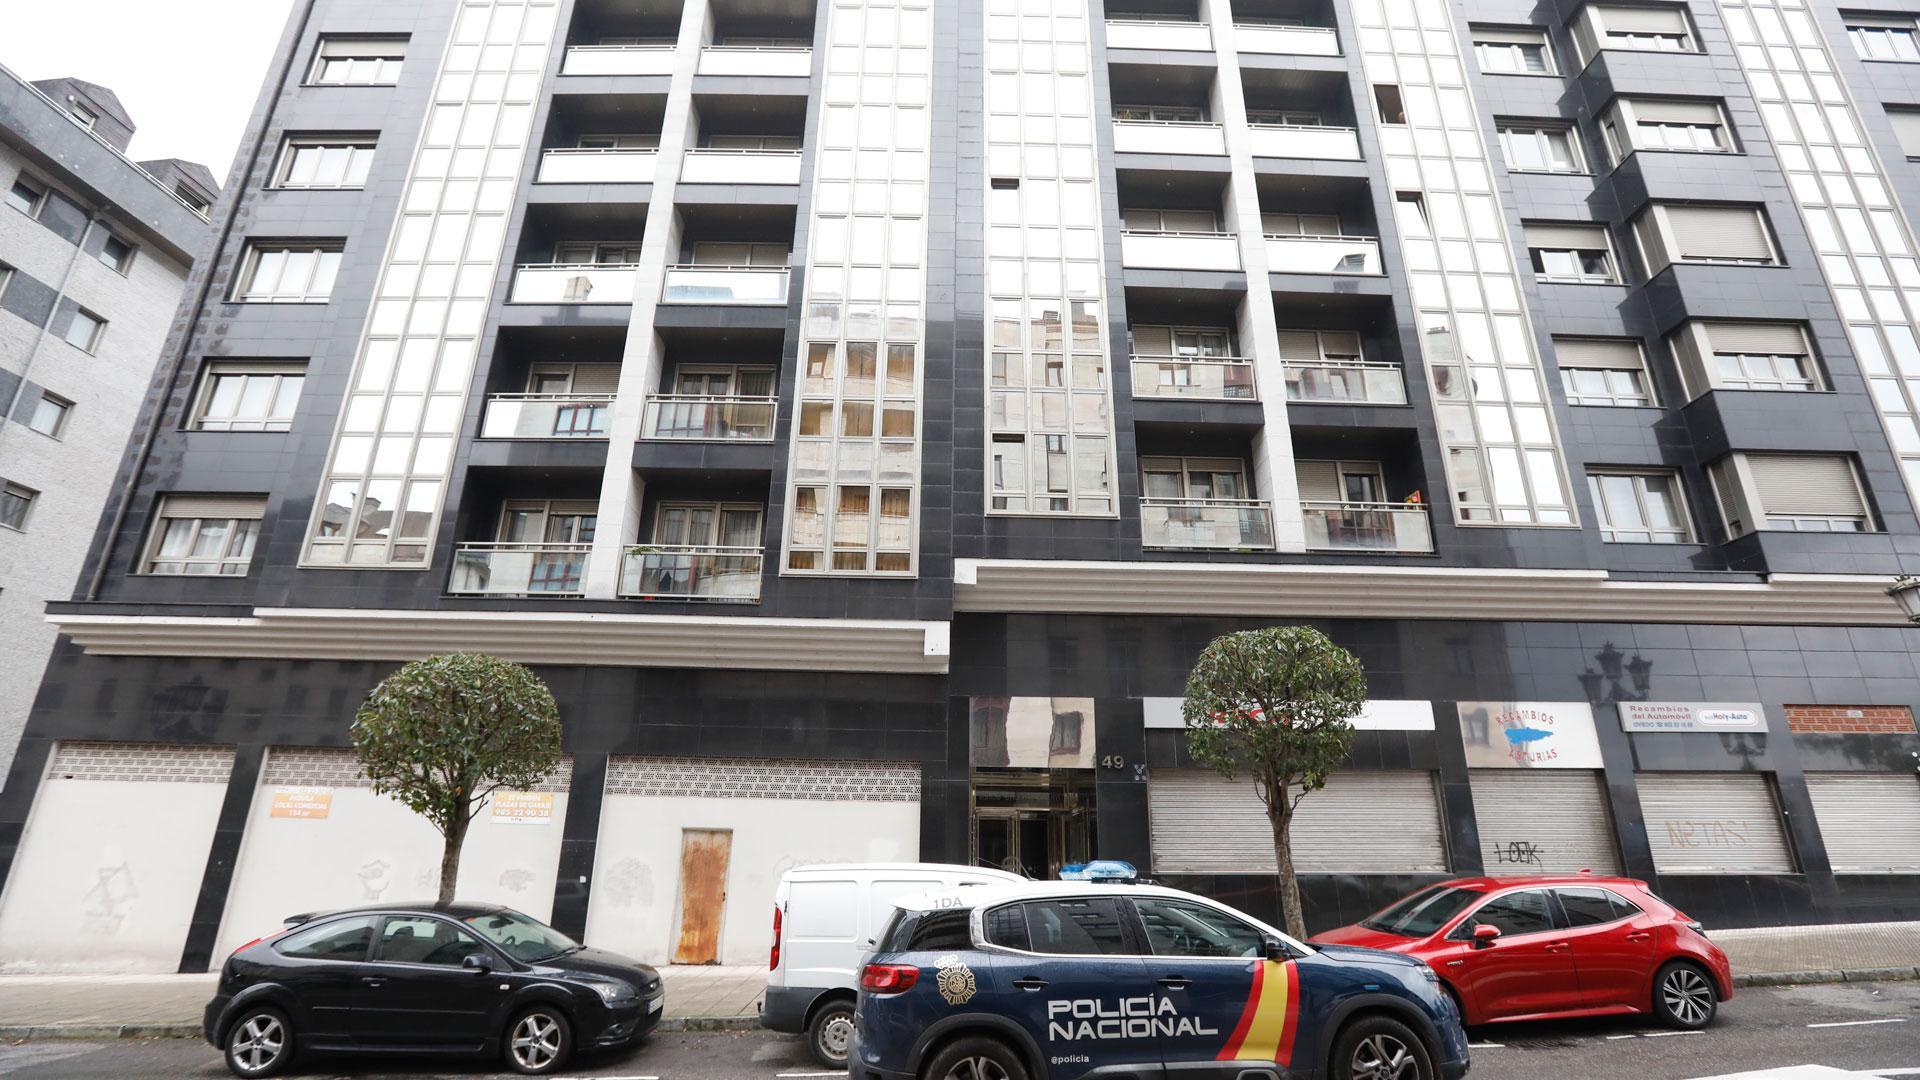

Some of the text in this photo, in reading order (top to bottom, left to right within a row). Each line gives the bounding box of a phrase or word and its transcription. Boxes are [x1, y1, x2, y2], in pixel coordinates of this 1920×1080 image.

[1495, 709, 1554, 726] RECAMBIOS
[1102, 755, 1125, 769] 49
[1507, 748, 1558, 763] ASTURIAS
[933, 896, 963, 909] 1DA
[1047, 993, 1178, 1020] POLICÍA
[1049, 1016, 1218, 1042] NACIONAL
[1051, 1054, 1090, 1064] @policia
